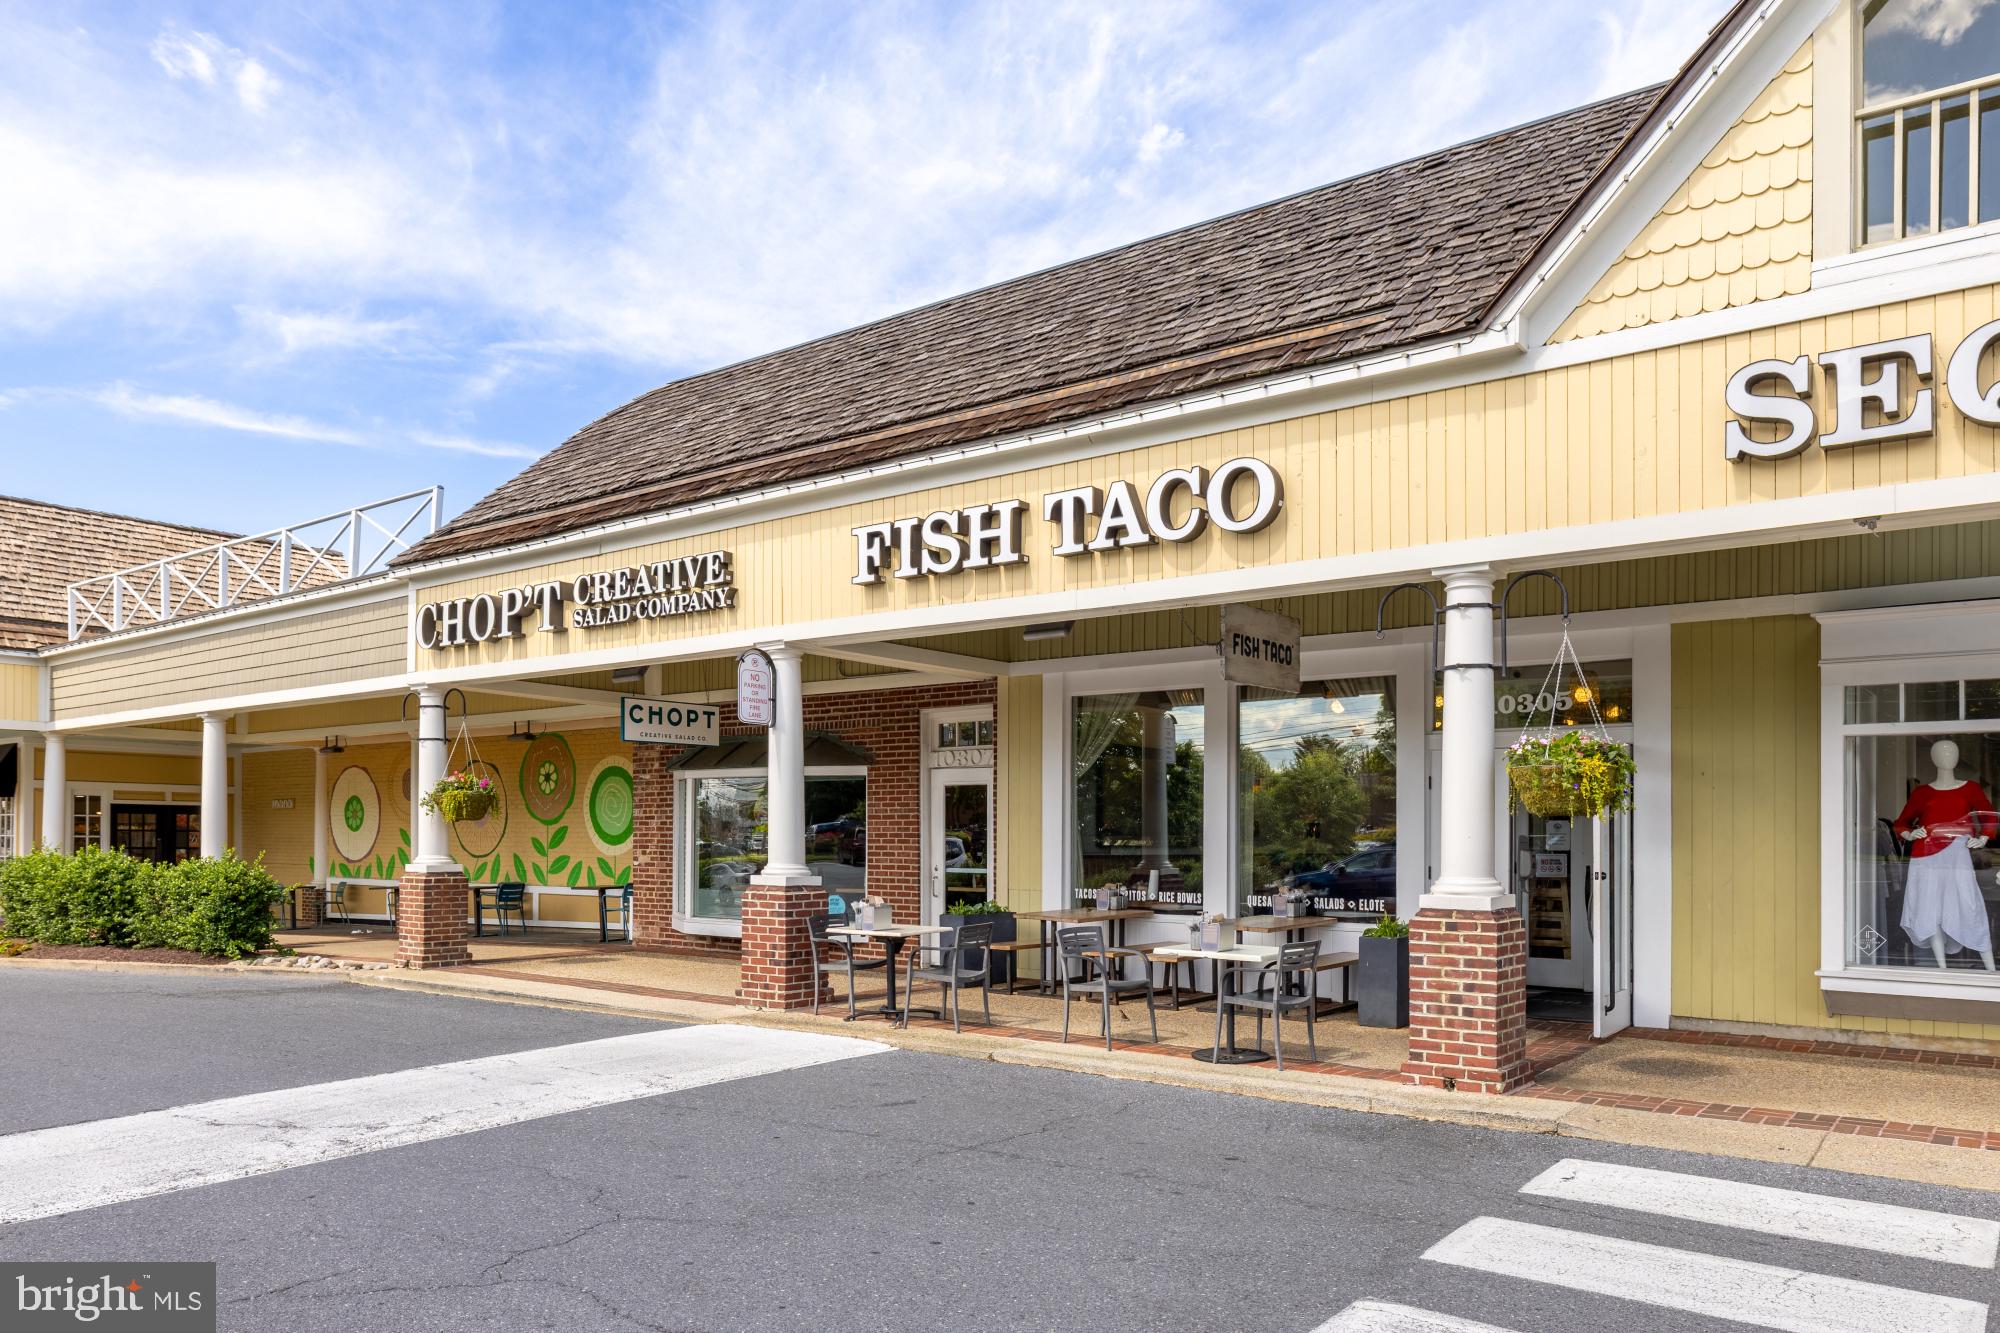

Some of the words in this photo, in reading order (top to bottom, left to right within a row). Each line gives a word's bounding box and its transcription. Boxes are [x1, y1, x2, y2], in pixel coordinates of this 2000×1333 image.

[851, 499, 1028, 585] FISH
[1043, 456, 1283, 557] TACO
[573, 551, 728, 605] CREATIVE
[416, 580, 563, 650] CHOP'T
[573, 603, 633, 629] SALAD
[636, 588, 731, 620] COMPANY
[1232, 632, 1260, 660] FISH
[1262, 638, 1293, 666] TACO
[743, 682, 766, 690] PARKING
[750, 673, 760, 681] NO
[742, 696, 768, 704] STANDING
[1495, 690, 1574, 714] 0305
[629, 704, 716, 729] CHOPT
[748, 711, 762, 719] LANE
[639, 731, 672, 739] CREATIVE
[1074, 888, 1098, 900] TACOS
[1158, 891, 1175, 903] RICE
[1176, 892, 1202, 904] BOWLS
[1314, 897, 1345, 911] SALADS
[1358, 898, 1385, 912] ELOTE
